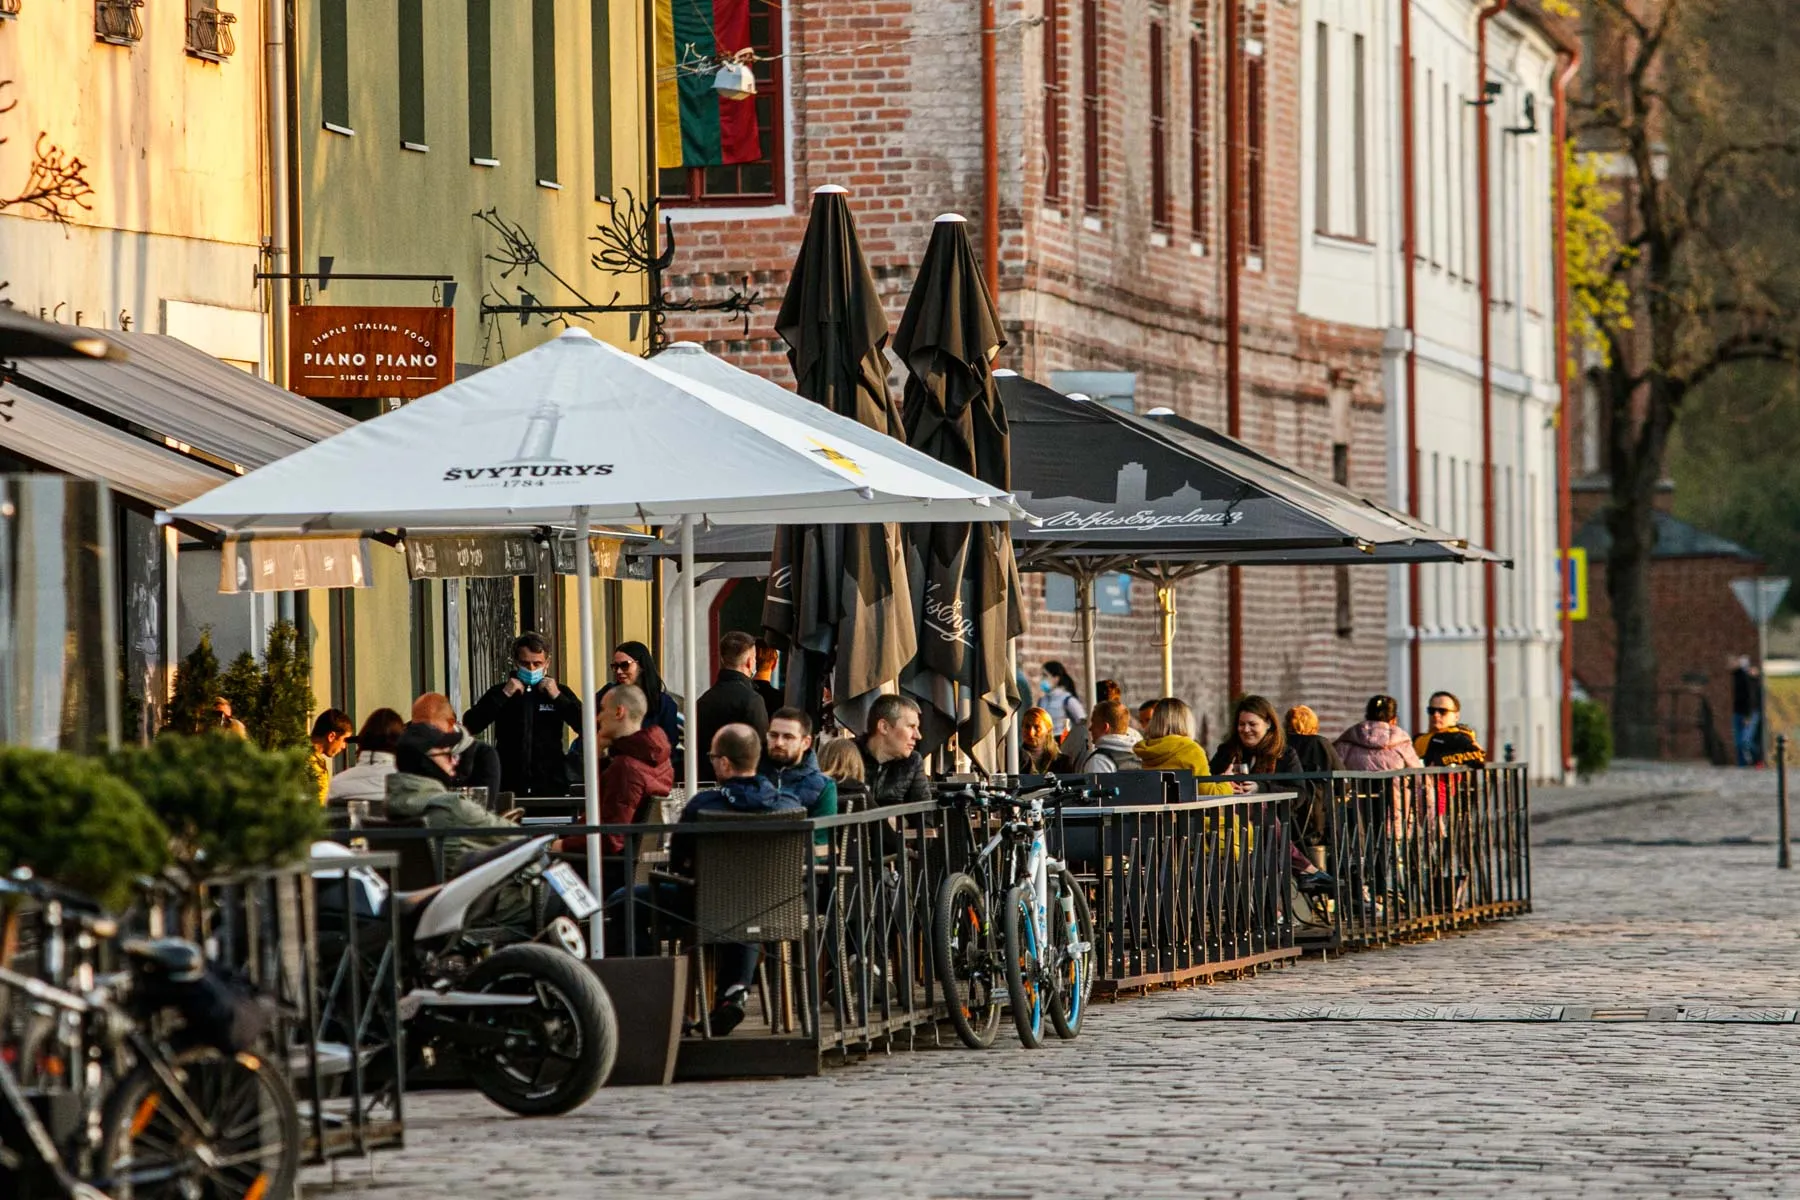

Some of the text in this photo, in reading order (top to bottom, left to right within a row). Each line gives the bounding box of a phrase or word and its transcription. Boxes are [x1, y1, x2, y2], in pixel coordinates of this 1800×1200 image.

[312, 323, 431, 348] SIMPLE ITALIAN FOOD
[304, 353, 438, 367] PIANO PIANO
[443, 464, 614, 481] ŠVYTURYS
[502, 479, 545, 488] 1784
